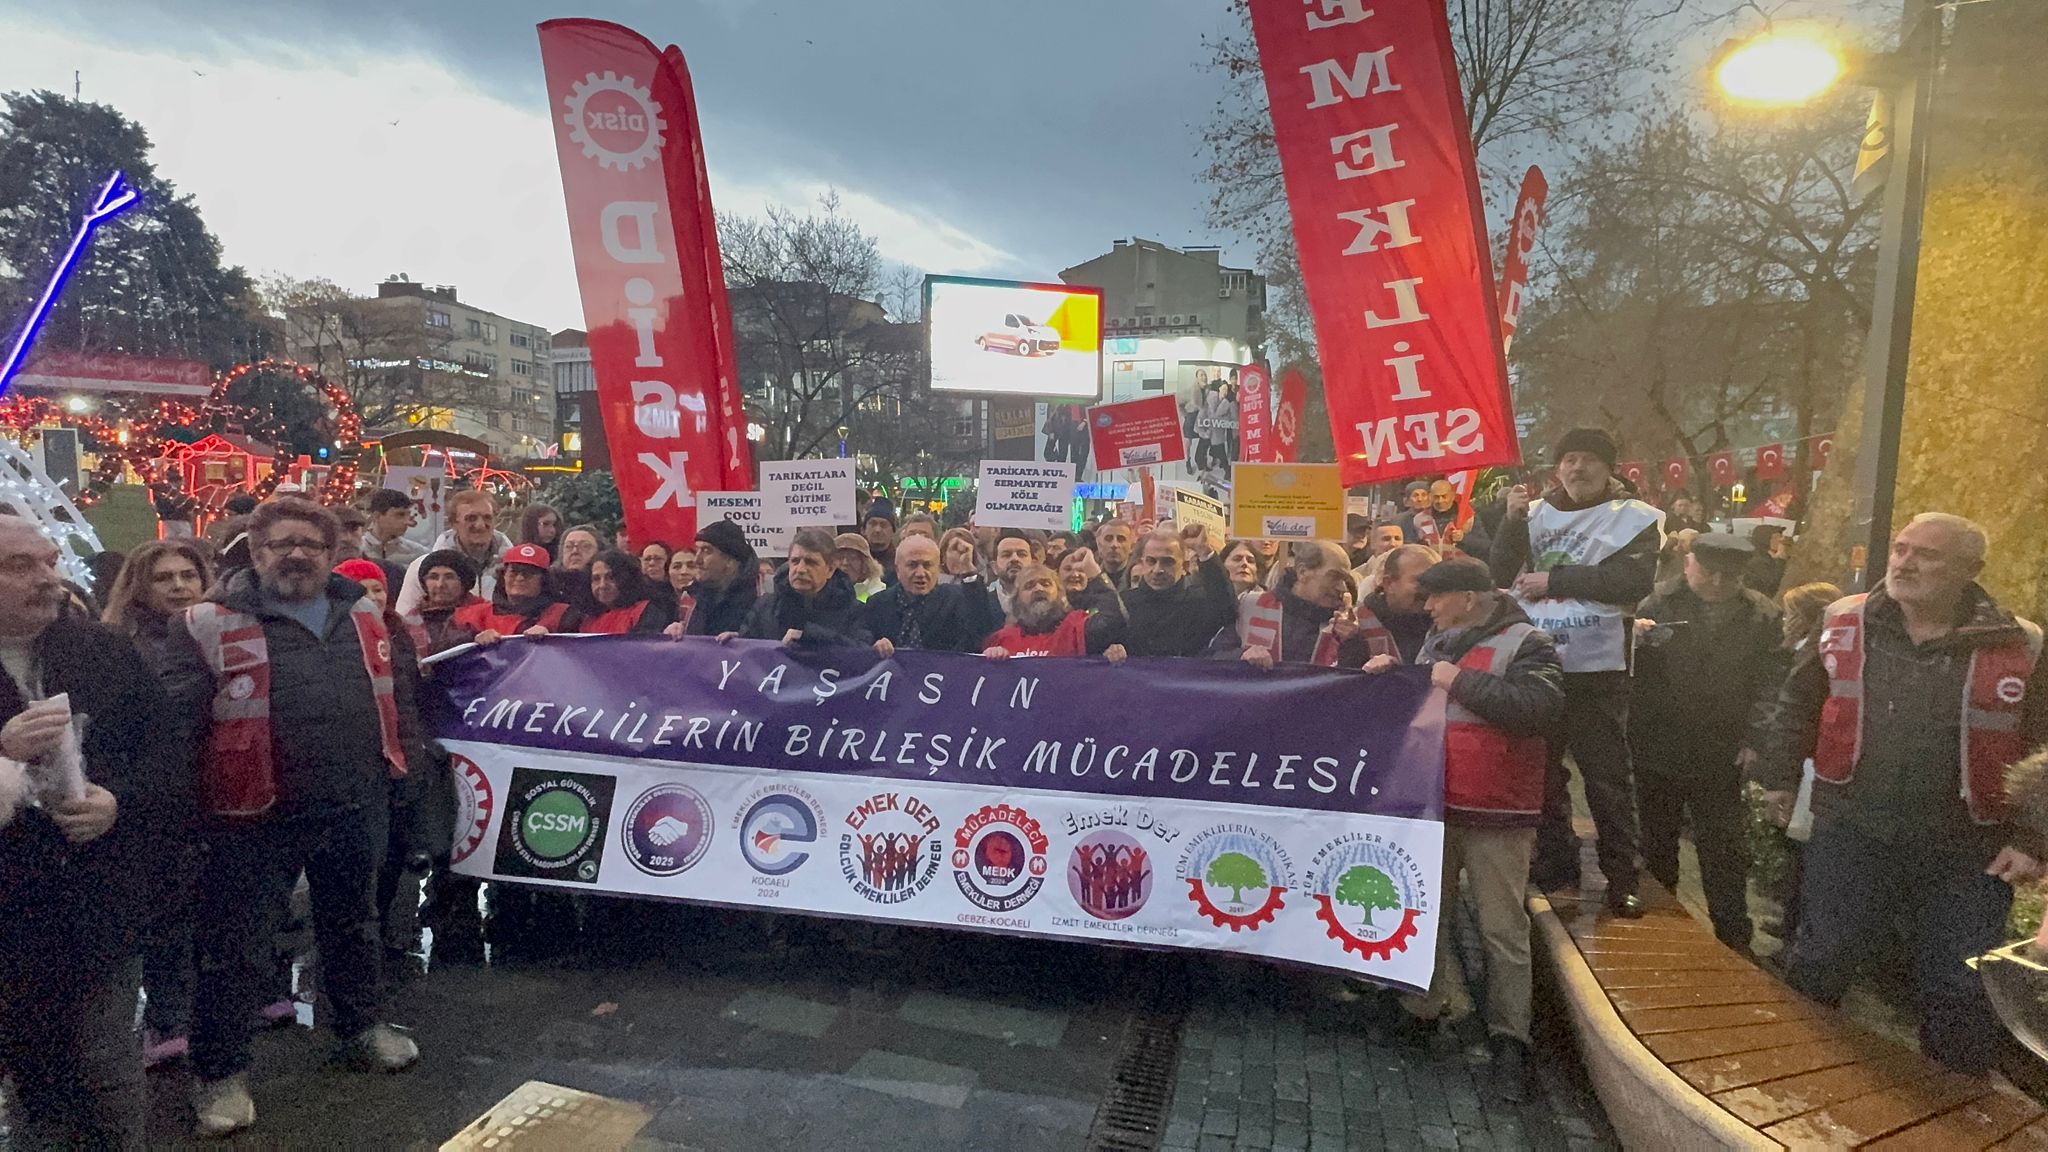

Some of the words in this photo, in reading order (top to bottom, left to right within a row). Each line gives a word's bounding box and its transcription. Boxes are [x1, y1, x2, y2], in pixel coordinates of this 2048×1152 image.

[986, 465, 1040, 476] TARİKATA
[1043, 469, 1068, 478] KUL,
[994, 479, 1058, 488] SERMAYEYE
[1011, 490, 1038, 499] KÖLE
[790, 505, 827, 516] BÜTÇE
[985, 502, 1063, 513] OLMAYACAĞIZ
[718, 660, 1040, 709] YAŞASIN
[463, 697, 763, 752] EMEKLİLERİN
[785, 718, 1006, 776] BİRLEŞİK
[1023, 737, 1379, 796] MÜCADELESİ.
[525, 780, 558, 800] SOSYAL
[751, 789, 761, 800] VE
[763, 783, 812, 799] EMEKÇİLER
[845, 793, 899, 830] EMEK
[904, 796, 941, 835] DER
[528, 812, 585, 833] ÇSSM
[1061, 805, 1129, 836] Emek
[1136, 807, 1180, 843] Der
[520, 849, 533, 862] STAJ
[649, 856, 674, 866] 2025
[1260, 833, 1298, 890] SENDİKASI
[982, 865, 1015, 878] MEDK
[757, 888, 780, 898] 2024
[957, 872, 1000, 910] EMEKLİLER
[1004, 878, 1040, 909] DERNEĞİ
[1357, 928, 1377, 939] 2021
